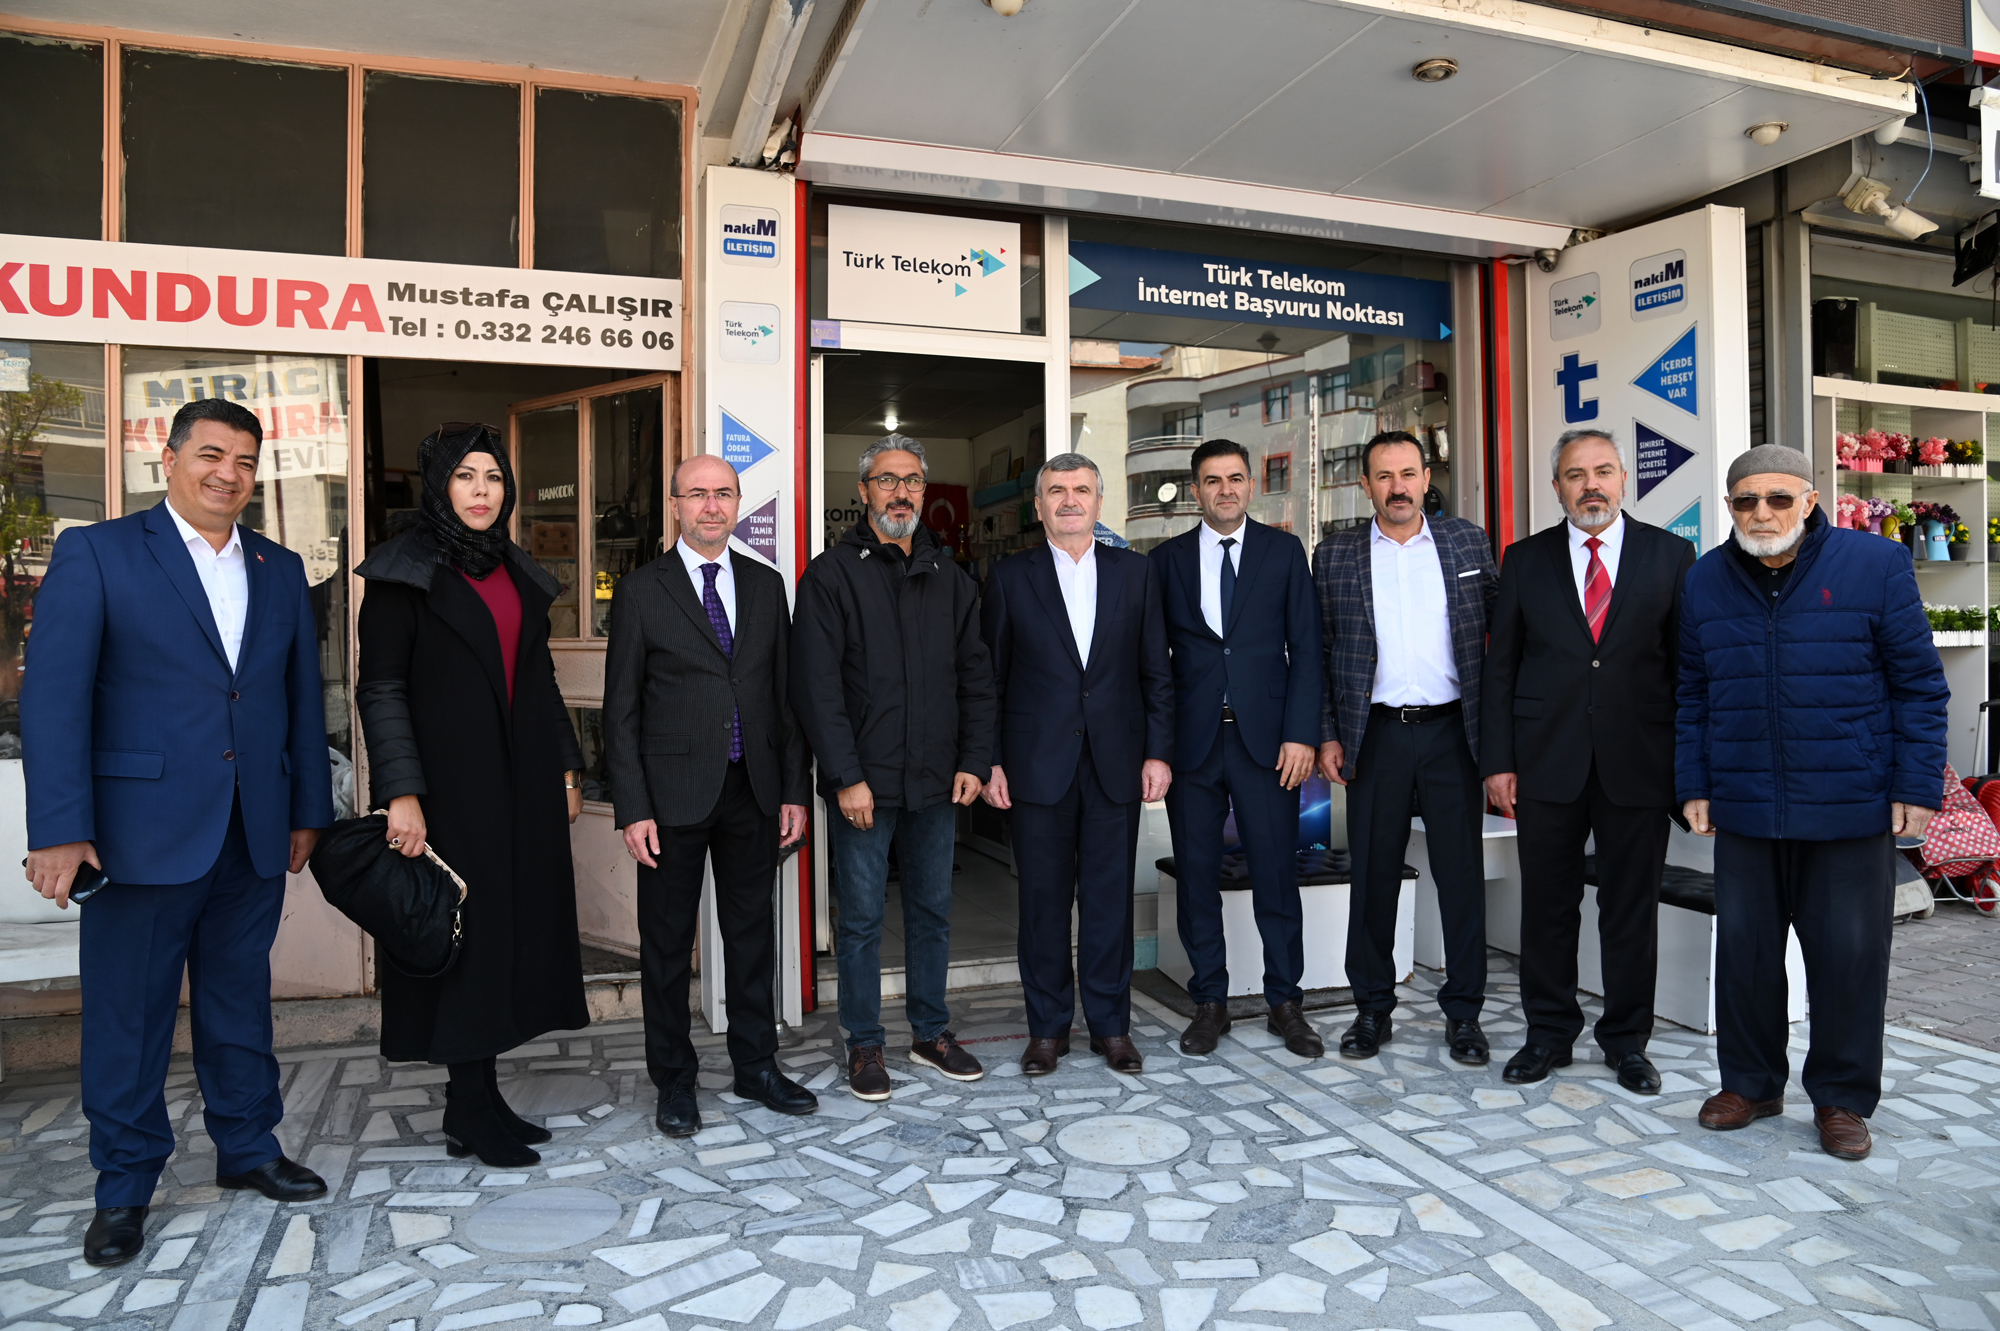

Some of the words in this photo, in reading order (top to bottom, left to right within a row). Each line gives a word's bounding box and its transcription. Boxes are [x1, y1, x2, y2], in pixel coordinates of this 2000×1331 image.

[724, 219, 777, 237] nakiM
[727, 240, 773, 255] İLETİŞİM
[842, 250, 885, 270] Türk
[891, 254, 971, 277] Telekom
[1203, 262, 1253, 288] Türk
[1257, 269, 1345, 297] Telekom
[1634, 259, 1684, 290] nakiM
[387, 281, 530, 309] Mustafa
[542, 291, 673, 322] ÇALIŞIR
[1138, 276, 1228, 309] İnternet
[1234, 295, 1320, 318] Başvuru
[1326, 301, 1404, 327] Noktası
[1553, 298, 1569, 308] Türk
[1637, 288, 1681, 307] İLETİŞİM
[1554, 302, 1584, 316] Telekom
[725, 320, 743, 329] Türk
[389, 315, 427, 337] Tel
[437, 323, 444, 338] :
[455, 319, 532, 343] 0.332
[541, 325, 592, 345] 246
[600, 327, 633, 348] 66
[642, 330, 674, 351] 06
[725, 328, 759, 338] Telekom
[1661, 356, 1693, 373] İÇERDE
[1660, 370, 1694, 387] HERŞEY
[1557, 353, 1598, 423] t
[1667, 387, 1687, 399] VAR
[726, 433, 751, 442] FATURA
[1639, 438, 1665, 449] SINIRSIZ
[727, 443, 750, 452] ÖDEME
[1638, 448, 1667, 459] İNTERNET
[725, 453, 753, 463] MERKEZİ
[1638, 458, 1667, 470] ÜCRETSİZ
[1638, 469, 1668, 480] KURULUM
[538, 483, 575, 501] HANKOOK
[749, 515, 774, 524] TEKNİK
[750, 525, 773, 535] TAMİR
[1672, 523, 1699, 538] TÜRK
[747, 536, 776, 546] HİZMETİ
